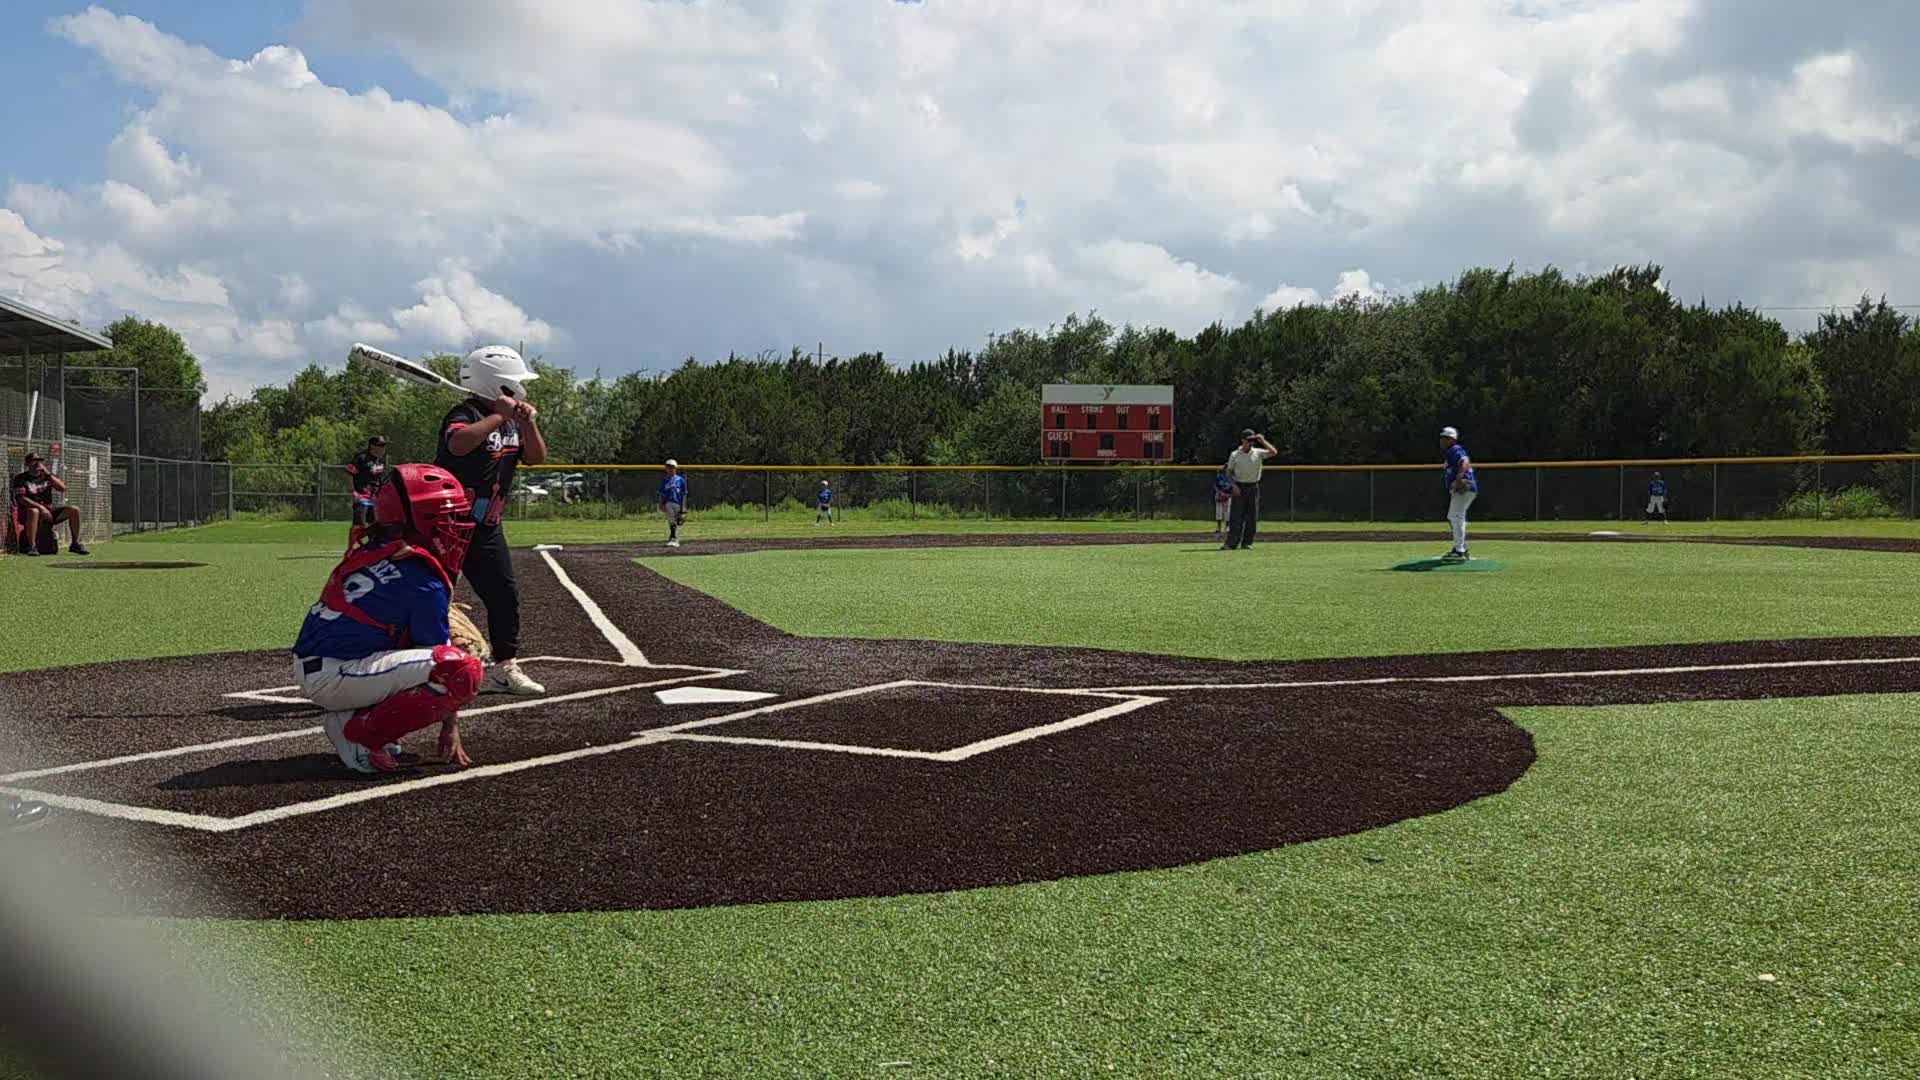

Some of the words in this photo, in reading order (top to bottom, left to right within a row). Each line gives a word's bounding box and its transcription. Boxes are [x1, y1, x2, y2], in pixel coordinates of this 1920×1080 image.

[1051, 405, 1070, 414] BALL
[1080, 405, 1104, 414] STRIKE
[1115, 406, 1130, 414] OUT
[1047, 431, 1073, 441] GUEST
[1142, 432, 1165, 442] HOME
